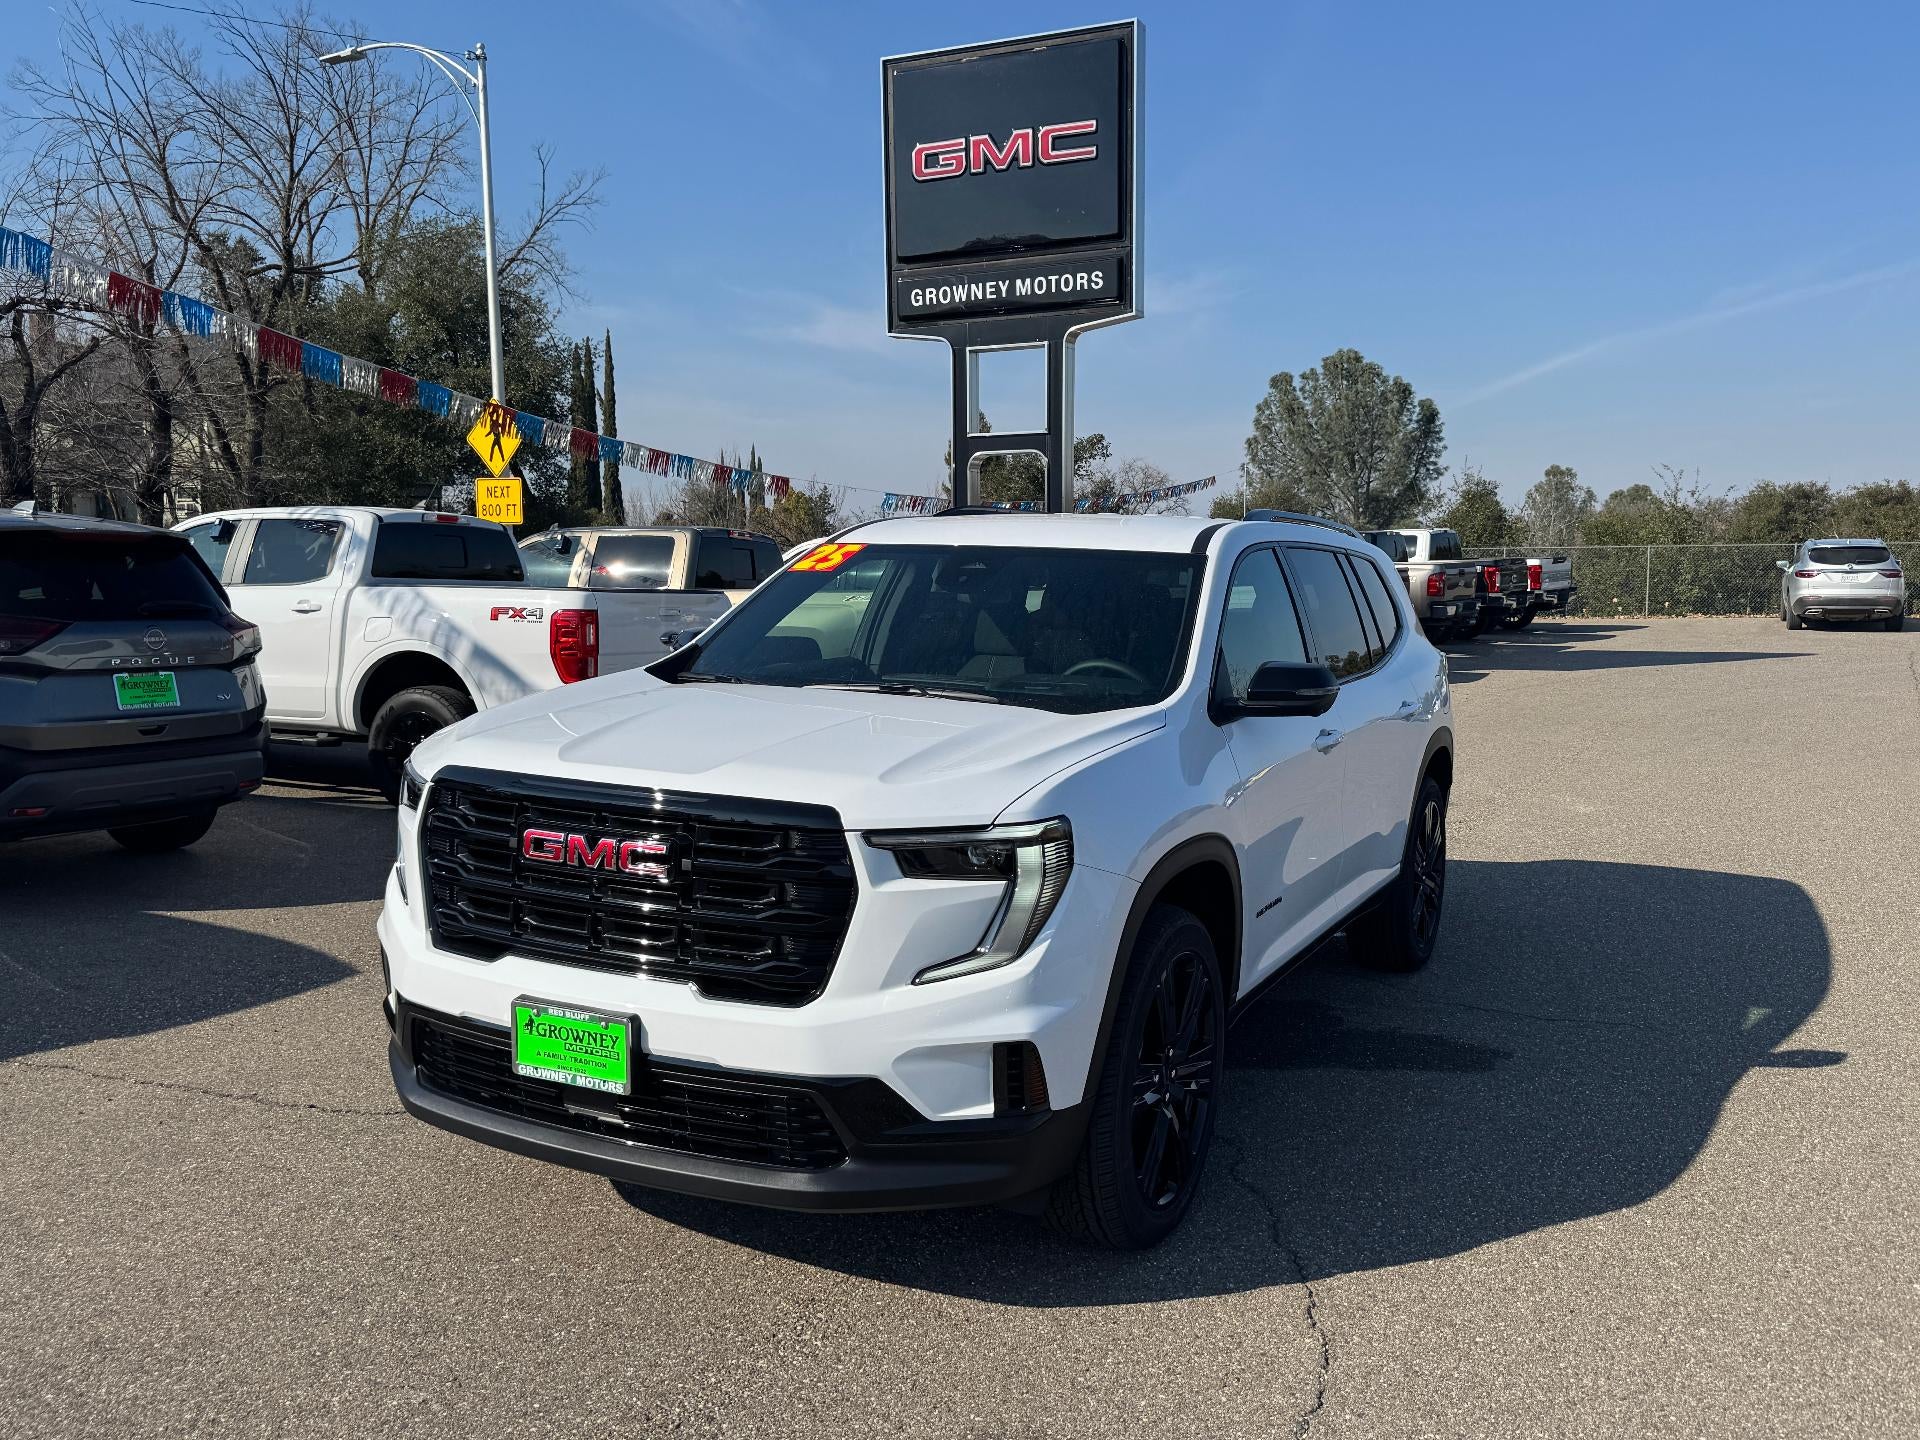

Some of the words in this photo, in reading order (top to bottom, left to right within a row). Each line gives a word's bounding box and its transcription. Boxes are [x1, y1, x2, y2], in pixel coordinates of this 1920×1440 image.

[912, 119, 1097, 181] GMC
[910, 280, 1010, 306] GROWNEY
[1015, 271, 1104, 296] MOTORS
[486, 486, 511, 498] NEXT
[482, 504, 501, 517] 800
[506, 504, 517, 516] FT
[790, 544, 862, 571] 25
[490, 607, 544, 621] FX4
[112, 656, 196, 665] ROGUE
[126, 680, 170, 690] GROWNEY
[523, 829, 668, 878] GMC
[548, 1008, 564, 1017] RED
[566, 1010, 590, 1021] BLUFF
[536, 1022, 620, 1050] GROWNEY
[565, 1043, 619, 1059] MOTORS
[543, 1051, 567, 1061] FAMILY
[570, 1056, 608, 1070] TRADITION
[518, 1065, 573, 1084] GROWNEY
[576, 1075, 624, 1094] MOTORS
